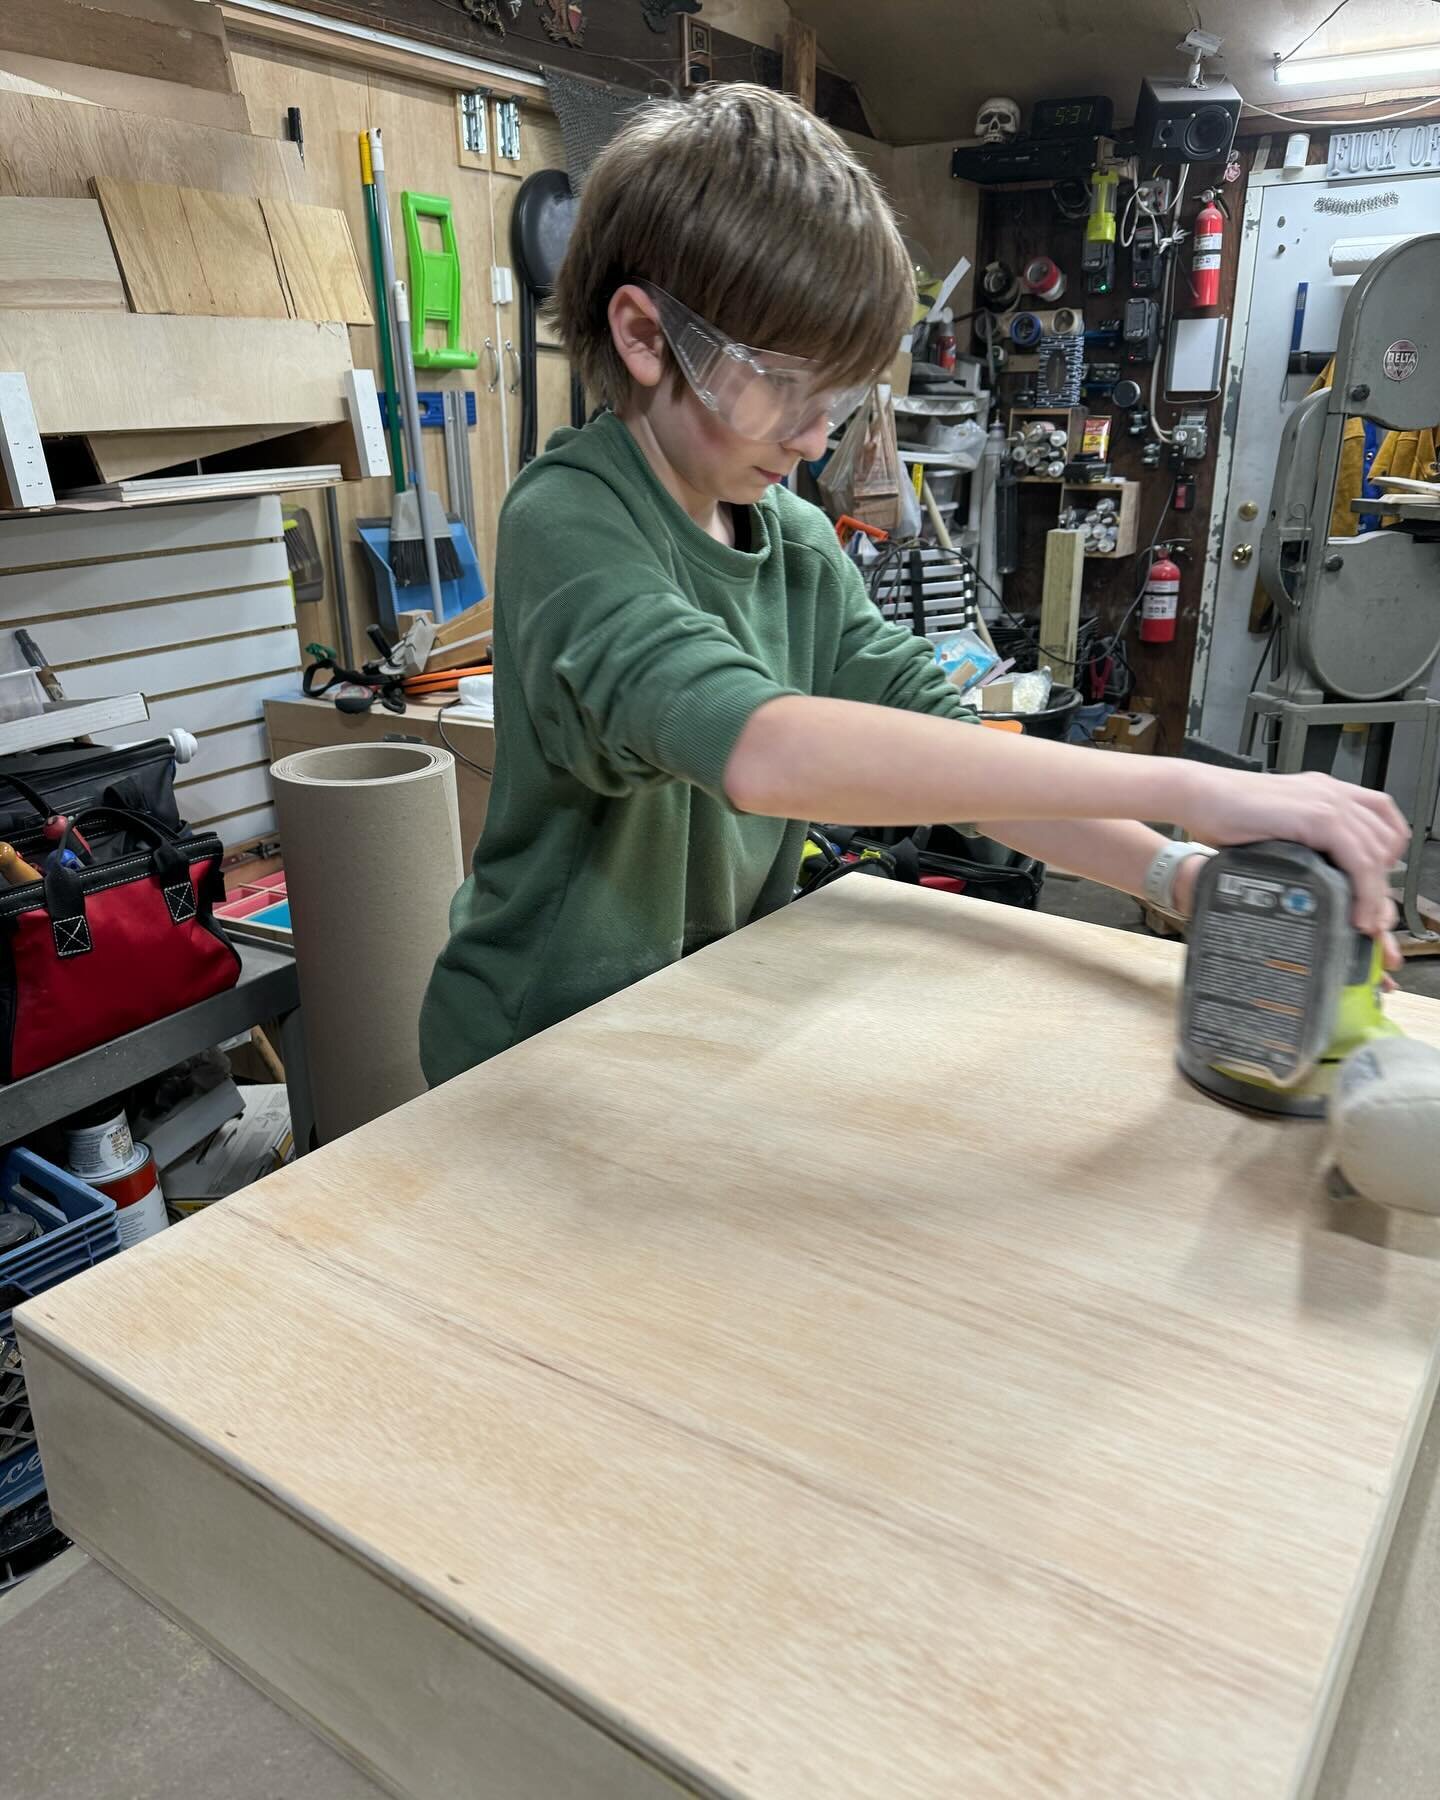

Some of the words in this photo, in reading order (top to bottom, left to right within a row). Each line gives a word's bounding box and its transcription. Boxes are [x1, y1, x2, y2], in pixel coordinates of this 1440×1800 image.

[1055, 105, 1094, 126] 5:31
[1332, 128, 1400, 176] FUCK
[1410, 126, 1440, 167] OF
[1387, 352, 1416, 363] DELTA
